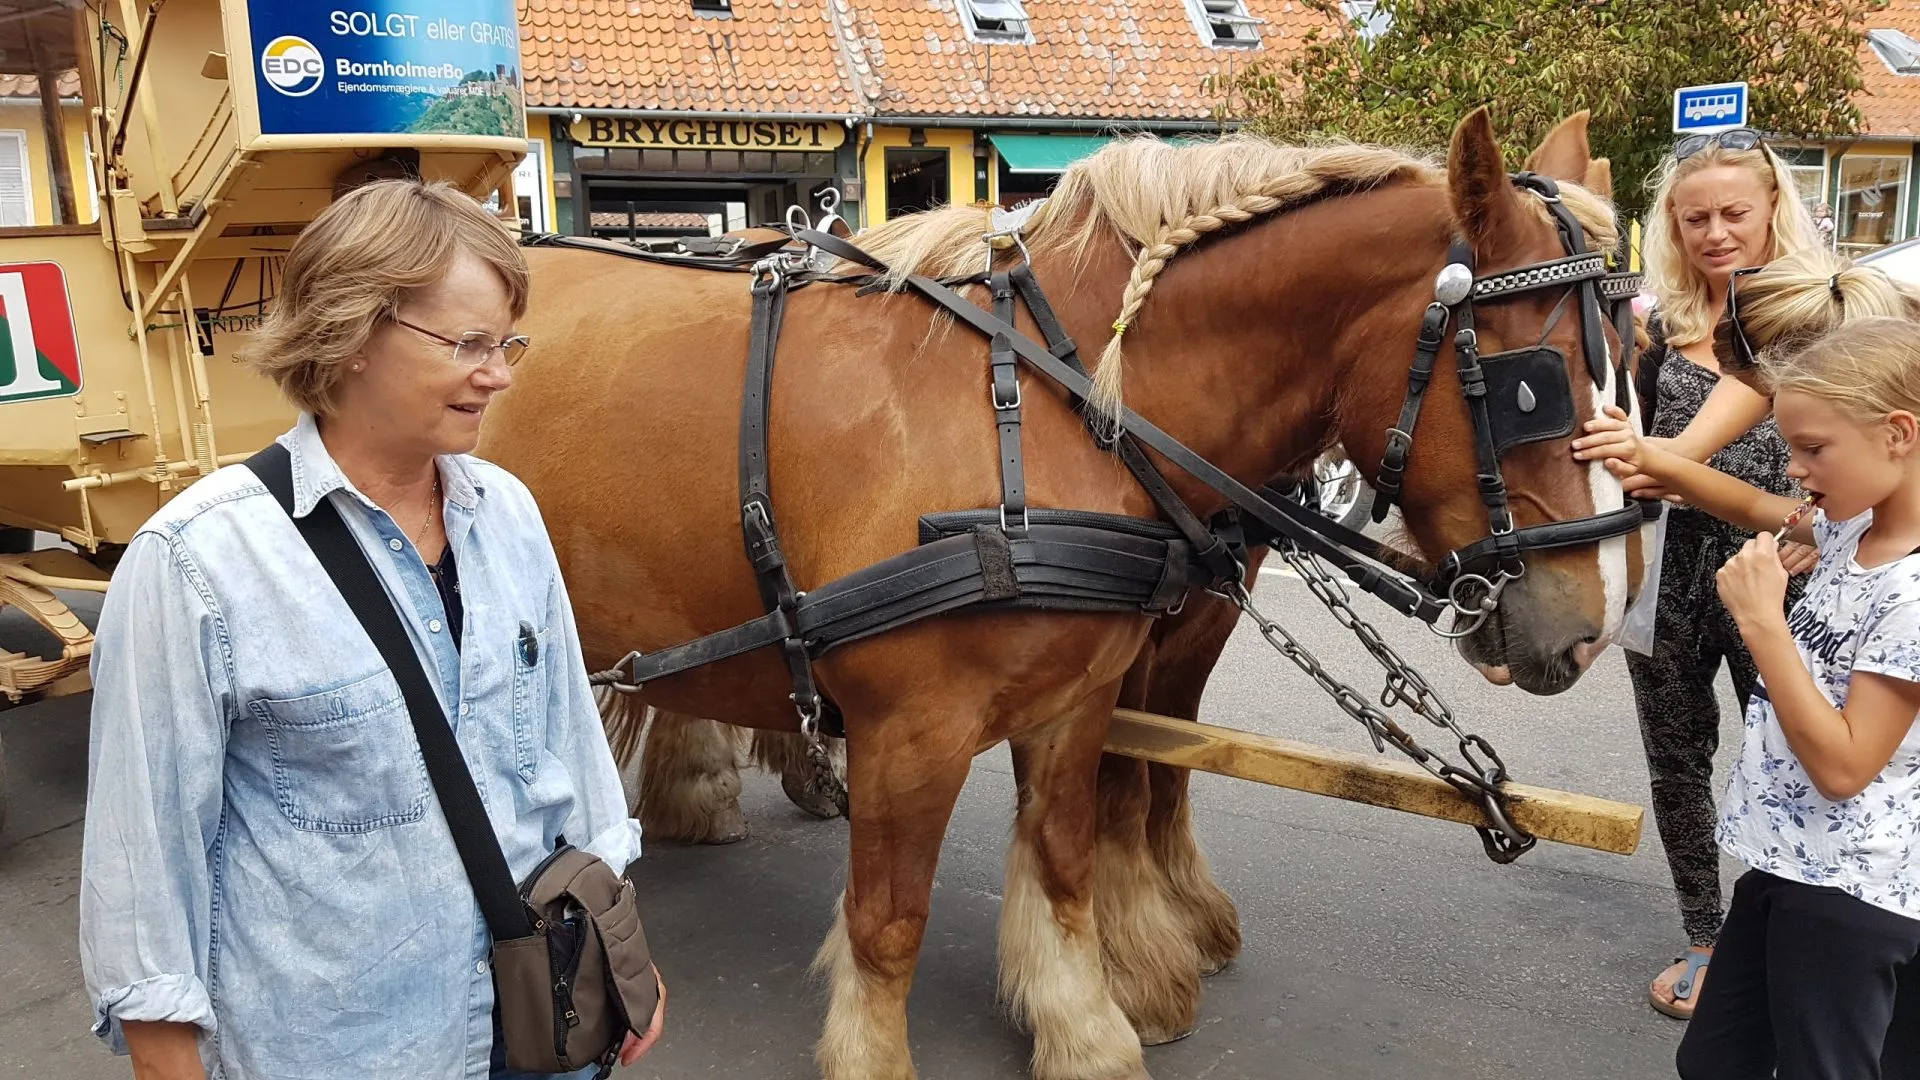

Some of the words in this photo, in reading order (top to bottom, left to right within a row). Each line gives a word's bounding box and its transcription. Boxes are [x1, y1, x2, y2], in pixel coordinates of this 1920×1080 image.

[330, 10, 419, 38] SOLGT
[426, 18, 466, 41] eller
[265, 57, 322, 75] EDC
[335, 58, 464, 80] BornholmerBo
[337, 81, 427, 98] Ejendomsmæglere
[588, 116, 828, 147] BRYGHUSET
